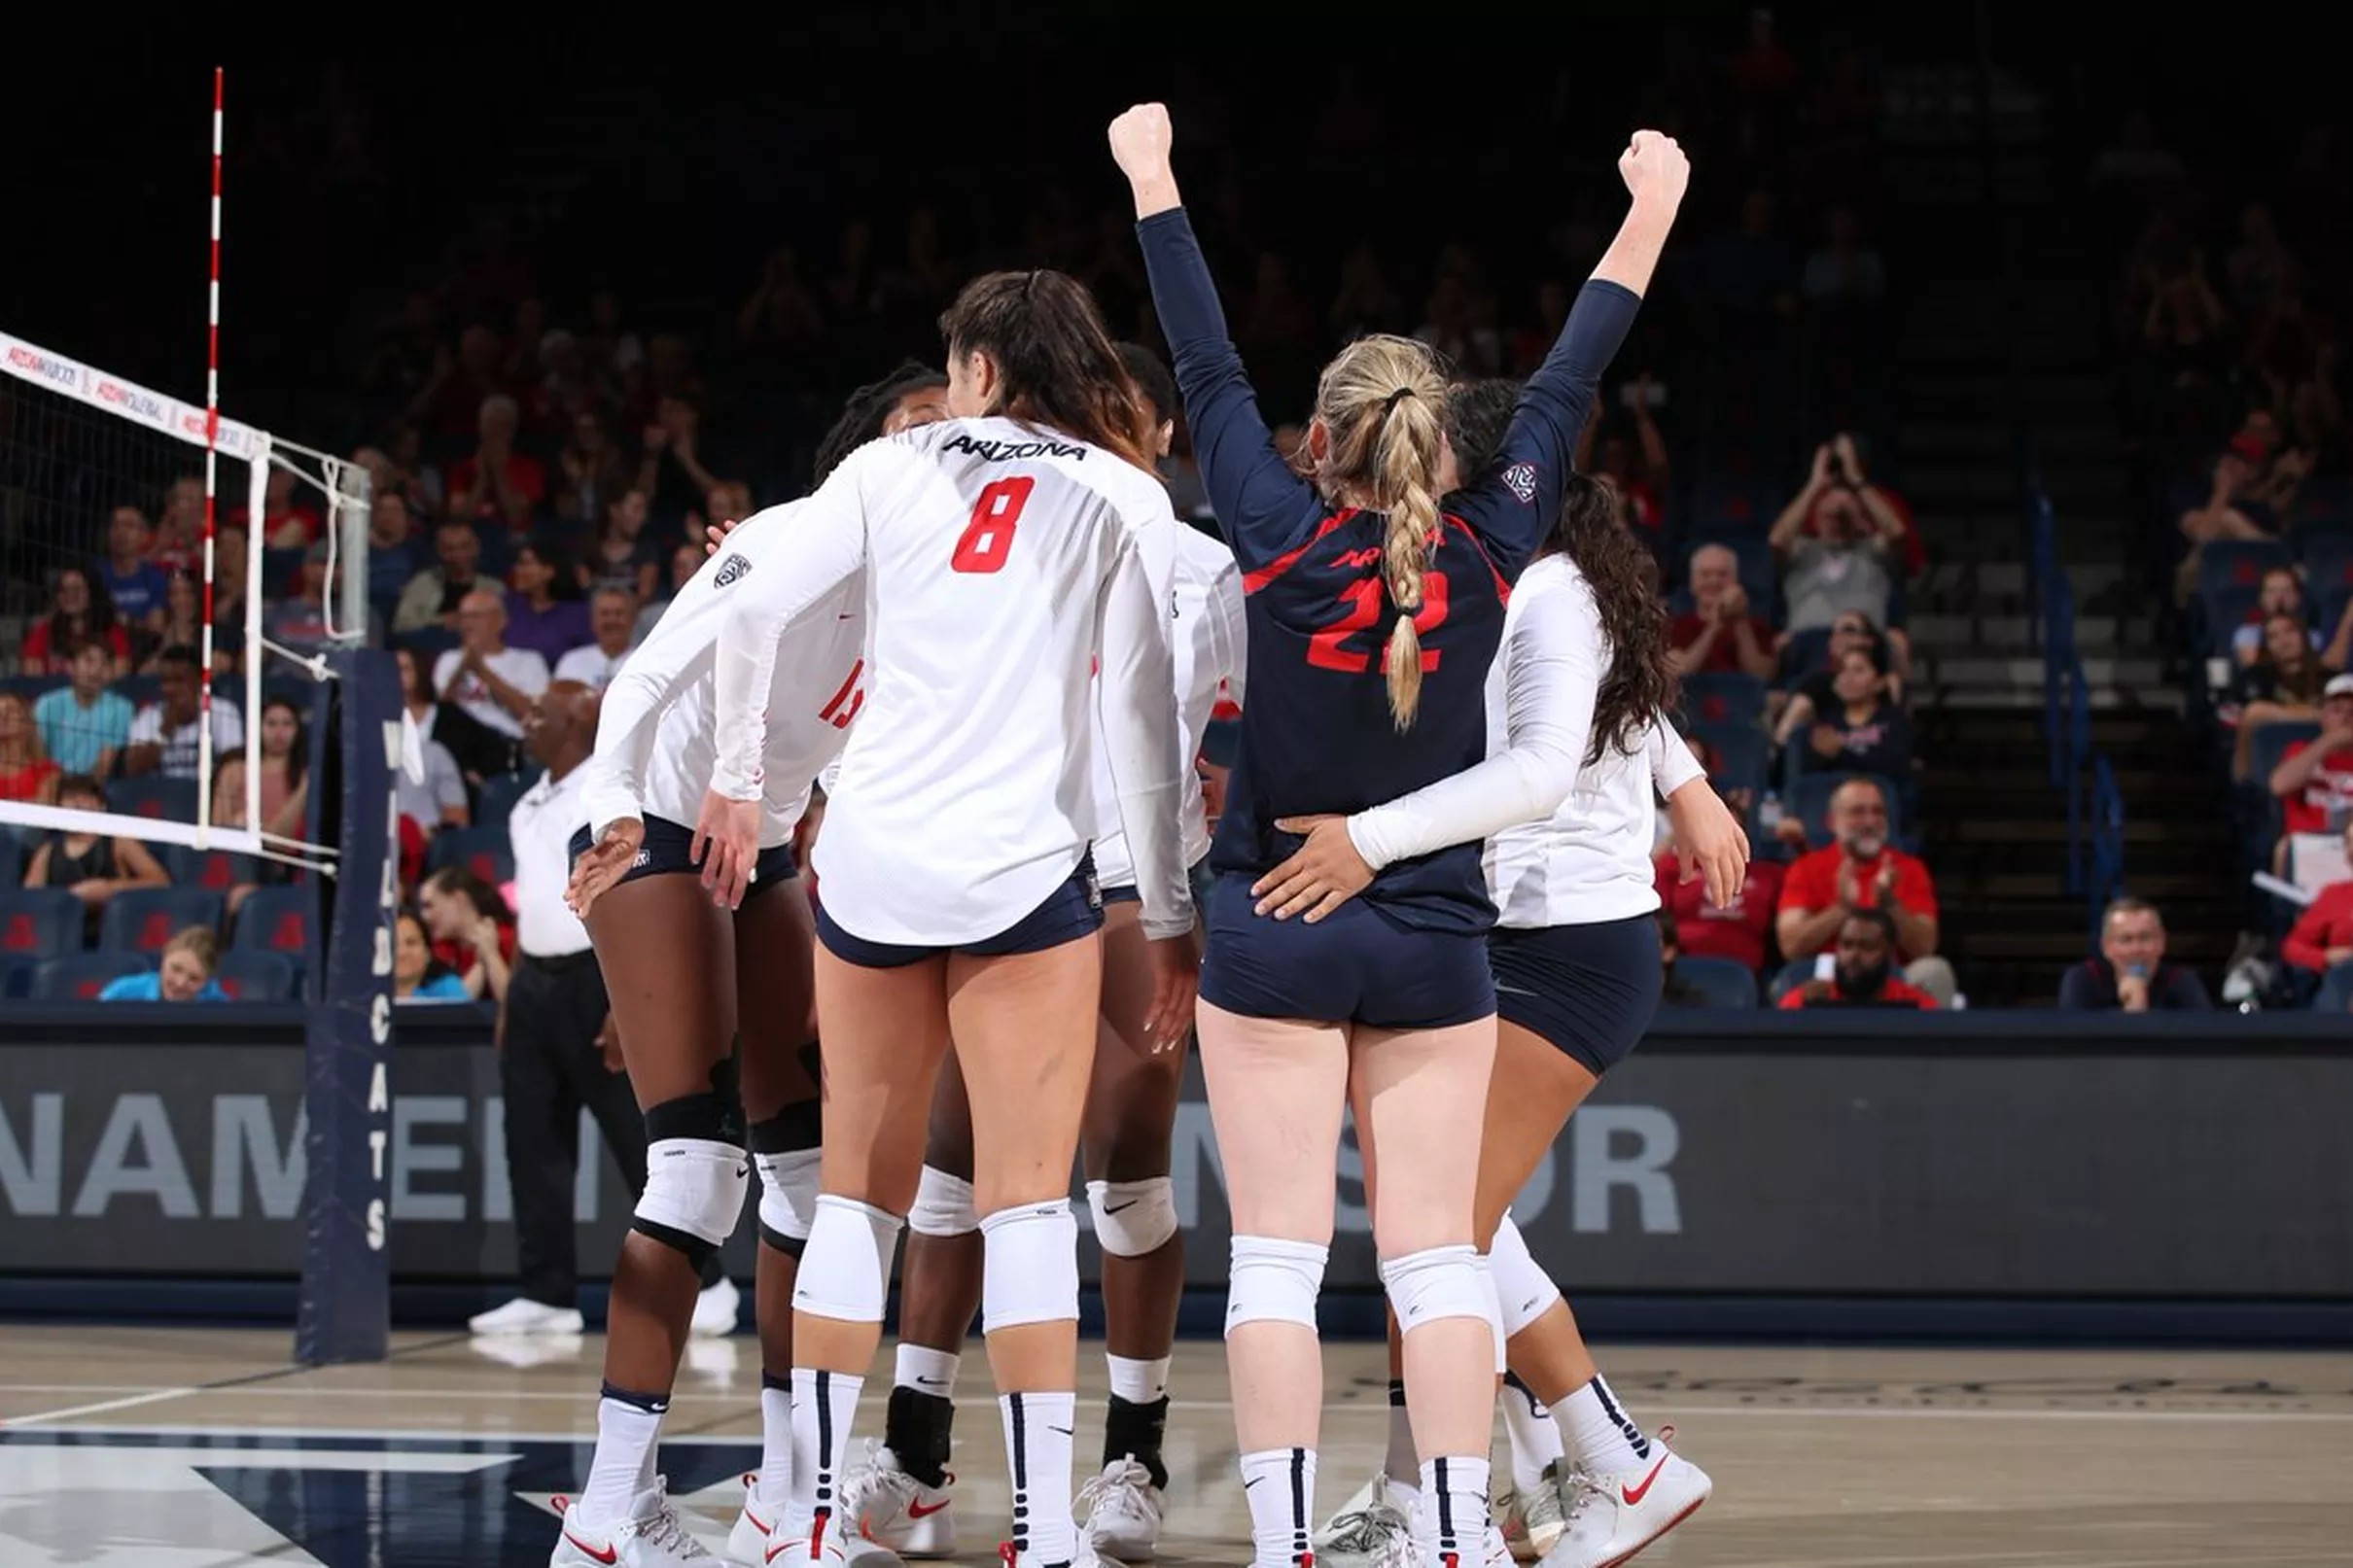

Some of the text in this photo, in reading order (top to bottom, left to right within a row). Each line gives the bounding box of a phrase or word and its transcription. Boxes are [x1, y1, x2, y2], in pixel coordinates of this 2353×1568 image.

[942, 435, 1087, 462] ARIZONA
[950, 475, 1036, 574] 8
[1306, 571, 1450, 674] 22
